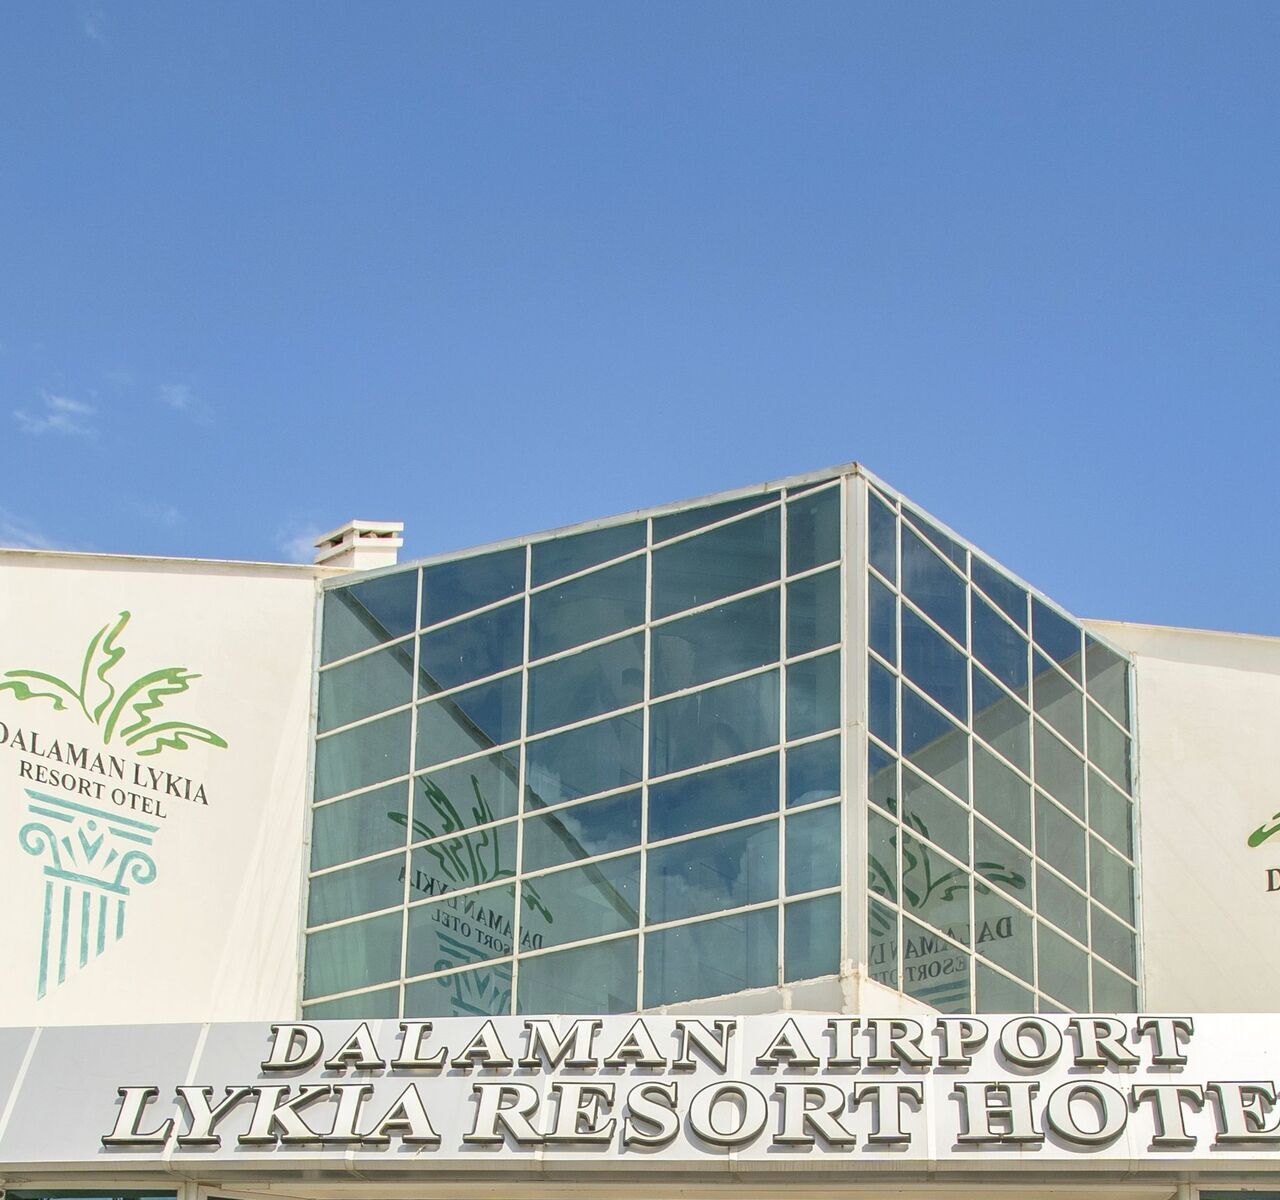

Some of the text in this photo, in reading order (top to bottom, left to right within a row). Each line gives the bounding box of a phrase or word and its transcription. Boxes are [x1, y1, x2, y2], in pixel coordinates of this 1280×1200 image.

[19, 759, 168, 818] RESORT OTEL
[132, 763, 210, 806] LYKIA
[260, 1015, 1194, 1073] DALAMAN AIRPORT
[101, 1081, 442, 1146] LYKIA
[462, 1079, 923, 1146] RESORT
